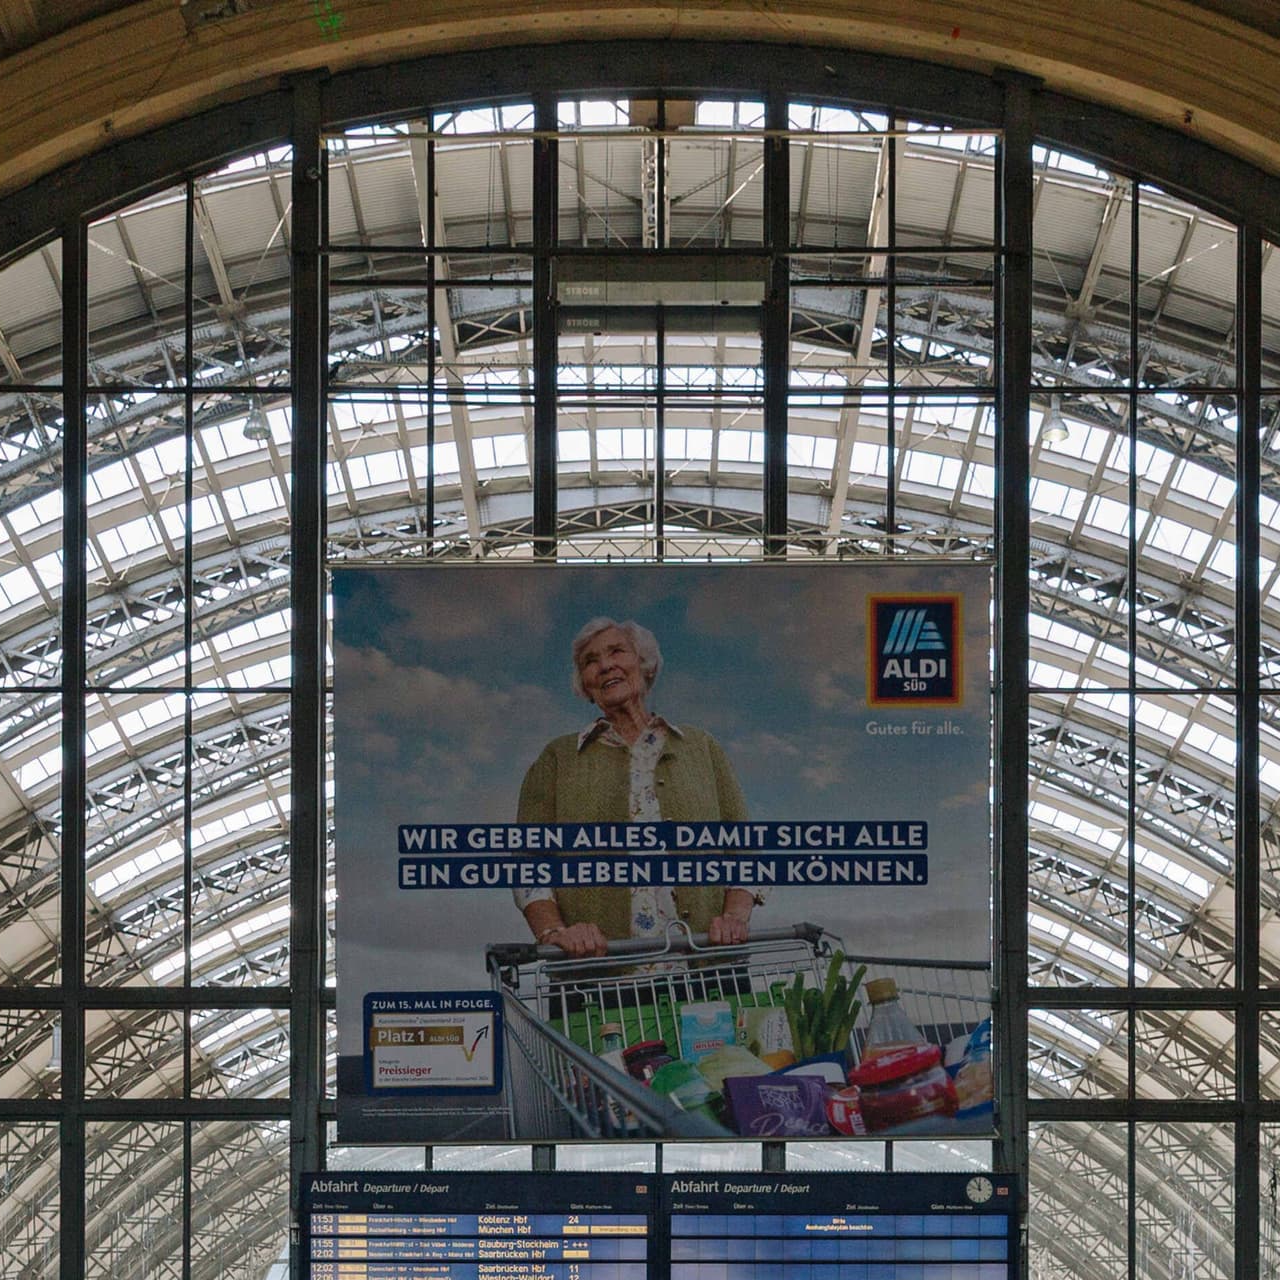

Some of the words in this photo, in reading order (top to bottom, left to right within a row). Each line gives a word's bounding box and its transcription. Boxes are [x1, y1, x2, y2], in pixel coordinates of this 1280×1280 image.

[883, 659, 947, 678] ALDI
[903, 679, 927, 691] SÜD
[866, 721, 908, 735] Gutes
[912, 721, 931, 735] für
[936, 721, 964, 735] alle.
[402, 828, 458, 849] WIR
[467, 827, 564, 849] GEBEN
[573, 826, 667, 852] ALLES,
[676, 825, 768, 847] DAMIT
[777, 825, 845, 847] SICH
[855, 825, 923, 847] ALLE
[402, 864, 450, 886] EIN
[460, 863, 552, 885] GUTES
[562, 862, 651, 884] LEBEN
[662, 861, 776, 883] LEISTEN
[787, 855, 924, 882] KÖNNEN.
[372, 1001, 396, 1010] ZUM
[399, 1001, 412, 1010] 15.
[414, 1000, 437, 1009] MAL
[440, 1000, 452, 1009] IN
[455, 999, 494, 1009] FOLGE.
[378, 1030, 415, 1043] Platz
[418, 1030, 425, 1042] 1
[378, 1066, 433, 1078] Preissieger
[311, 1180, 359, 1193] Abfahrt
[363, 1184, 411, 1196] Departure
[420, 1183, 449, 1196] Départ
[671, 1180, 719, 1193] Abfahrt
[724, 1184, 772, 1196] Departure
[781, 1183, 810, 1196] Départ
[311, 1216, 334, 1224] 11:53
[478, 1216, 510, 1224] Koblenz
[514, 1216, 528, 1224] Hbf
[568, 1216, 580, 1224] 24
[311, 1225, 334, 1233] 11:54
[478, 1225, 514, 1233] München
[517, 1225, 531, 1233] Hbf
[311, 1240, 334, 1248] 11:55
[478, 1240, 559, 1250] Glauburg-Stockheim
[311, 1250, 334, 1258] 12:02
[478, 1250, 529, 1258] Saarbrücken
[532, 1250, 546, 1258] Hbf
[311, 1265, 334, 1273] 12:02
[478, 1265, 529, 1273] Saarbrücken
[532, 1265, 546, 1273] Hbf
[568, 1265, 580, 1273] 11
